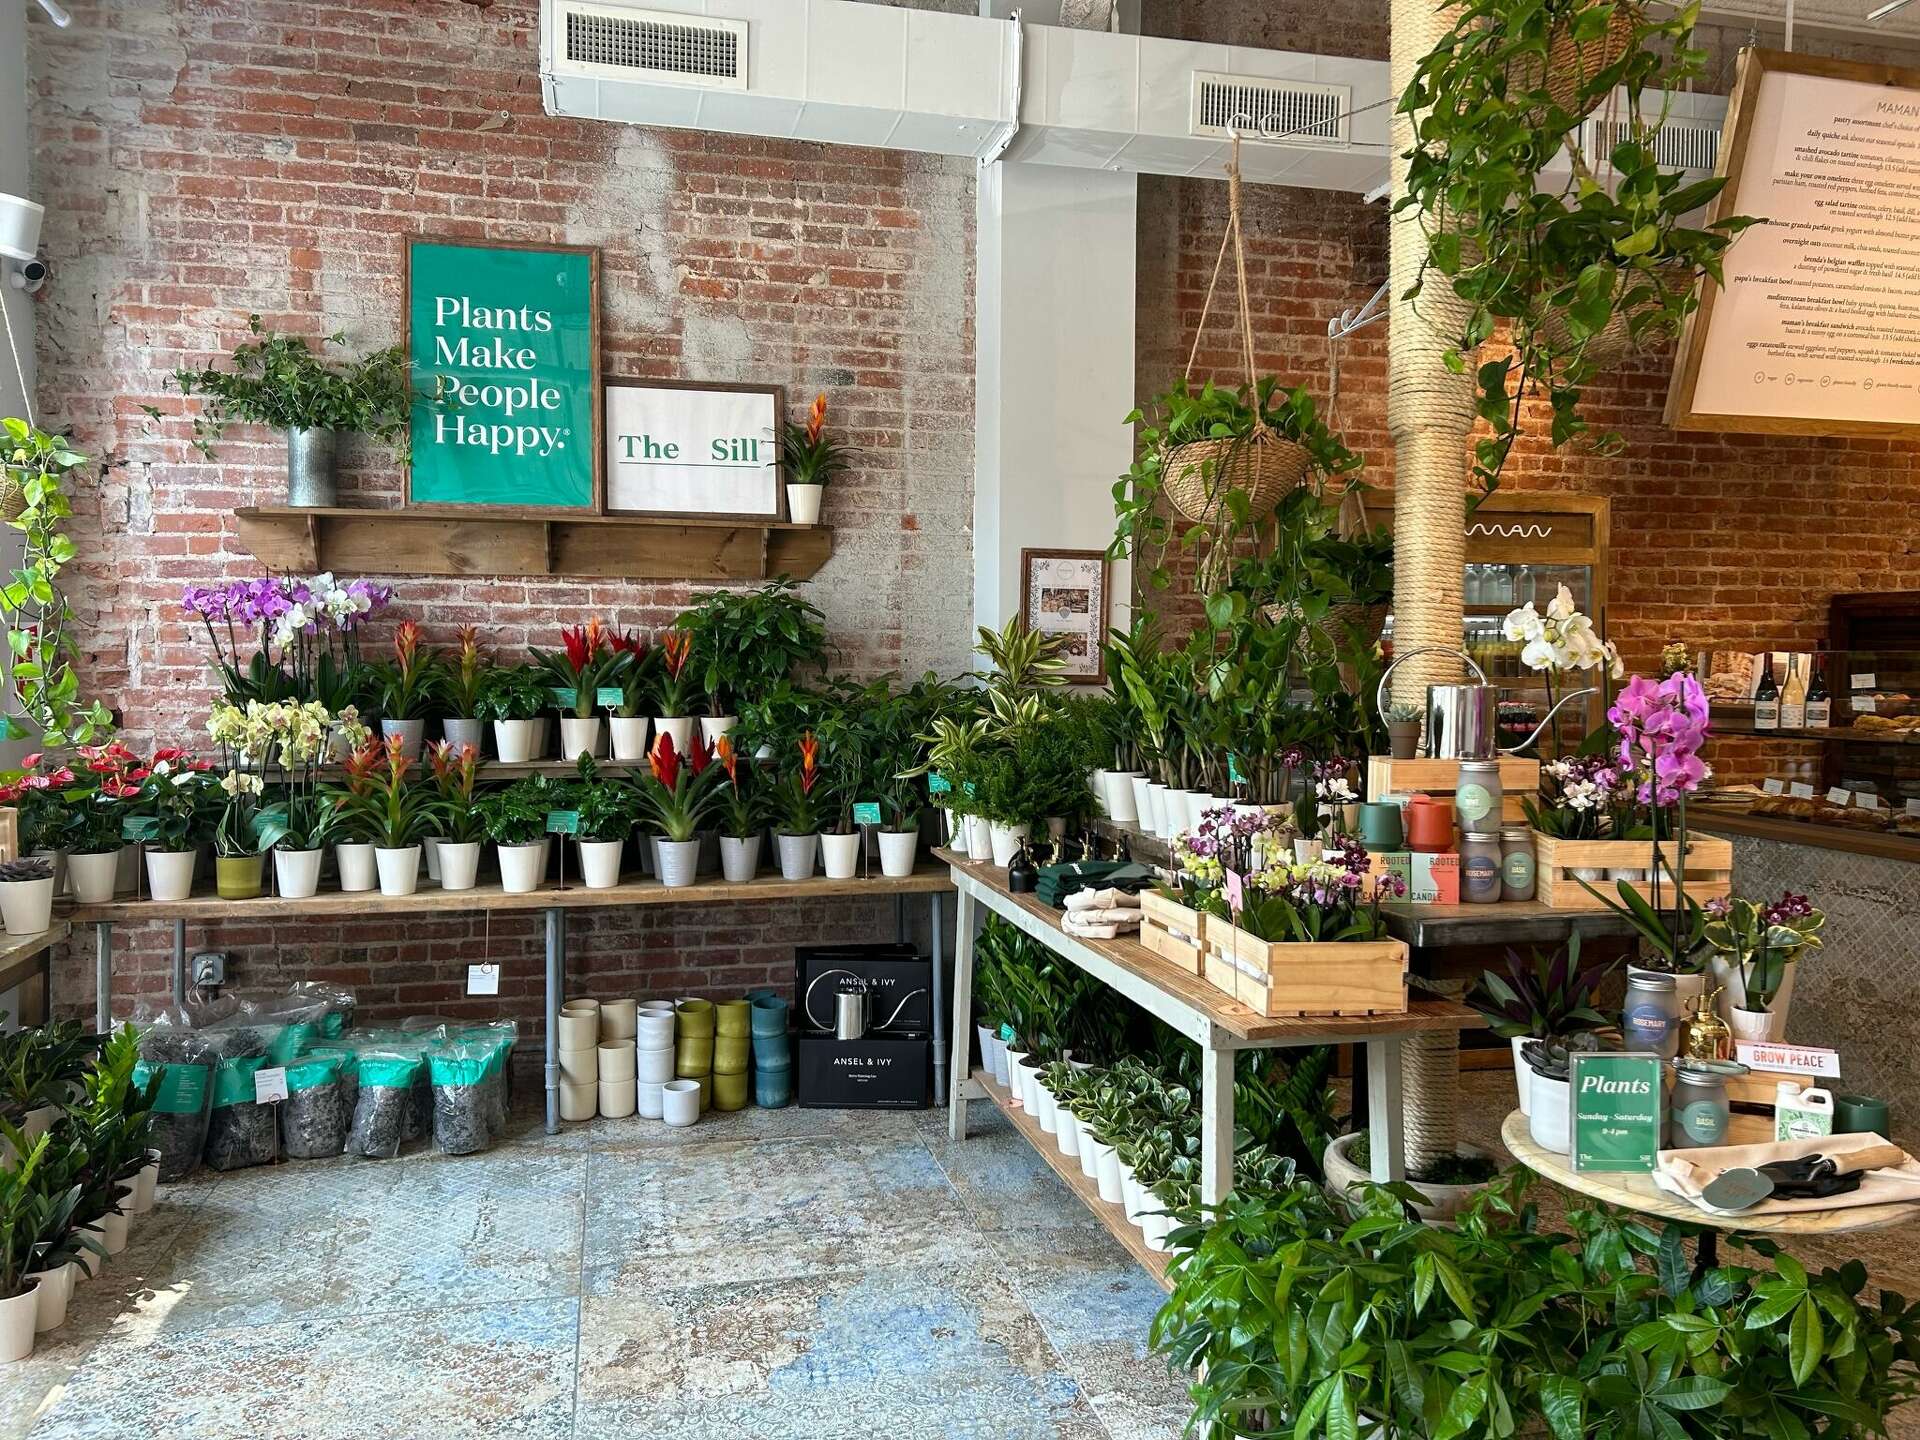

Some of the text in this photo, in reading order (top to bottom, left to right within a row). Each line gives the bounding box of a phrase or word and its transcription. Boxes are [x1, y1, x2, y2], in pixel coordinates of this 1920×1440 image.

[1876, 102, 1920, 117] MAMAN
[1833, 116, 1851, 126] pastry
[1807, 129, 1821, 140] daily
[1822, 132, 1841, 141] quiche
[1794, 146, 1818, 154] smashed
[1818, 149, 1840, 157] avocado
[1840, 151, 1859, 159] tartine
[1784, 170, 1800, 178] make
[1827, 175, 1851, 183] omelette
[1814, 200, 1824, 208] egg
[1825, 199, 1839, 207] salad
[1839, 201, 1858, 209] tartine
[1790, 221, 1812, 230] granola
[1811, 222, 1831, 232] parfait
[1782, 237, 1810, 247] overnight
[1803, 255, 1827, 263] brenda's
[1826, 257, 1846, 267] belgian
[1847, 259, 1866, 267] waffles
[1734, 275, 1752, 283] papa's
[1752, 275, 1779, 284] breakfast
[1778, 277, 1793, 285] bowl
[1766, 294, 1807, 303] mediterranean
[1806, 295, 1832, 305] breakfast
[1831, 297, 1846, 306] bowl
[435, 296, 552, 332] Plants
[1805, 320, 1830, 328] breakfast
[1830, 322, 1855, 330] sandwich
[435, 336, 536, 370] Make
[435, 374, 561, 416] People
[618, 435, 758, 462] The Sill
[1411, 891, 1443, 902] CANDLE
[839, 977, 896, 986] ANSEL & IVY
[1632, 1016, 1666, 1028] ROSEMARY
[833, 1057, 892, 1066] ANSEL & IVY
[1753, 1049, 1786, 1065] GROW
[1789, 1053, 1824, 1068] PEACE
[1581, 1075, 1651, 1094] Plants
[1577, 1112, 1609, 1122] Sunday
[1613, 1113, 1654, 1124] Saturday
[1695, 1117, 1715, 1127] BASIL
[1580, 1153, 1592, 1161] The
